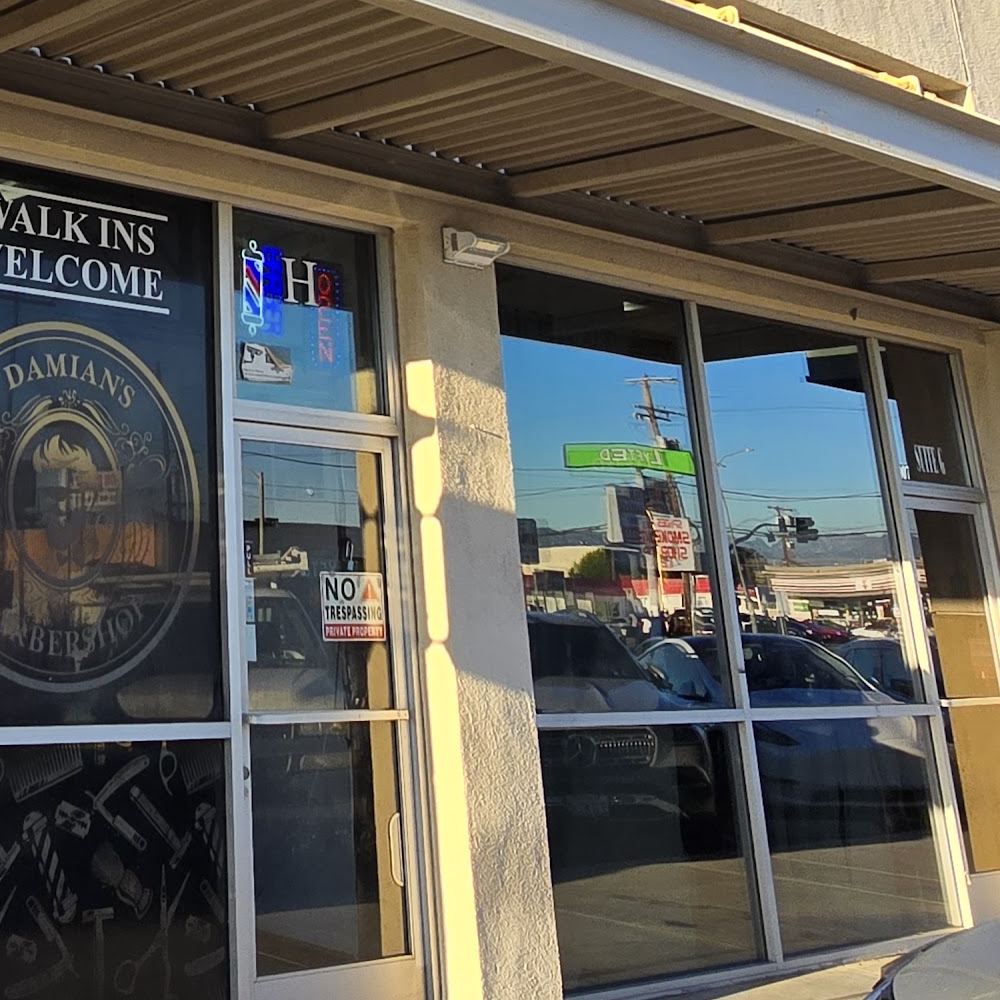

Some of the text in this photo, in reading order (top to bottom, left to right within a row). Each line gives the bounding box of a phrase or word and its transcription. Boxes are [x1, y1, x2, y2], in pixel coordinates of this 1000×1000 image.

[98, 216, 155, 256] INS
[281, 256, 320, 307] H
[3, 353, 135, 408] DAMIAN'S
[325, 577, 356, 601] NO
[325, 605, 383, 621] TRESPASSING
[325, 625, 383, 637] PRIVATE PROPERTY
